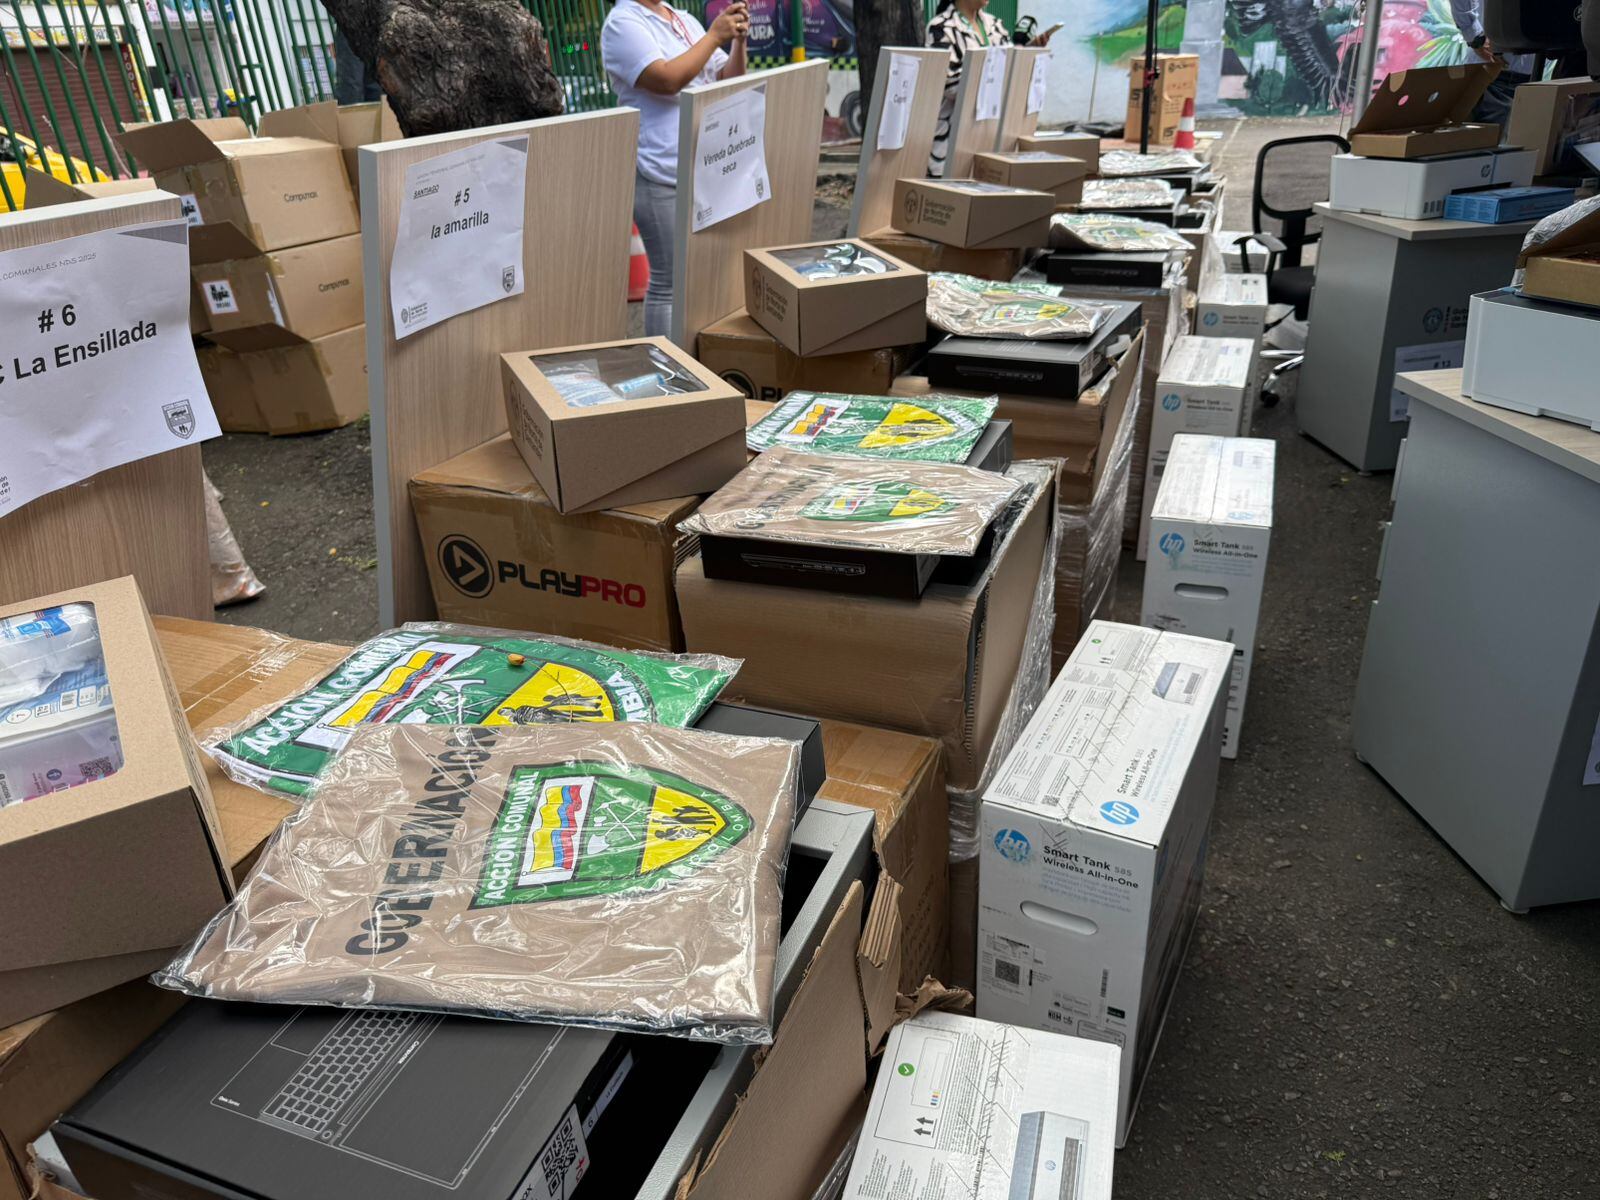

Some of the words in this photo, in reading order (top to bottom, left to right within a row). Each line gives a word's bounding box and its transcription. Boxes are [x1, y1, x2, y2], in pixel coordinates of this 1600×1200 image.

[703, 149, 726, 167] Vereda
[727, 135, 756, 156] Quebrada
[413, 184, 440, 198] SANTIAGO
[454, 190, 462, 207] #
[463, 187, 470, 203] 5
[430, 225, 441, 239] la
[443, 210, 489, 236] amarilla
[2, 261, 58, 280] COMUNALES
[37, 308, 55, 334] #
[61, 304, 77, 327] 6
[14, 355, 47, 380] La
[54, 320, 158, 368] Ensillada
[1194, 539, 1218, 548] Smart
[1221, 541, 1240, 550] Tank
[497, 560, 647, 609] PLAYPRO
[1116, 774, 1131, 795] Smart
[1126, 757, 1140, 775] Tank
[1131, 773, 1147, 798] Wireless
[509, 771, 540, 832] COMUNAL
[1100, 801, 1140, 825] hp
[1042, 856, 1084, 875] Wireless
[1086, 869, 1139, 889] All-in-One
[1043, 845, 1079, 863] Smart
[1082, 855, 1111, 871] Tank
[1114, 865, 1132, 877] 585
